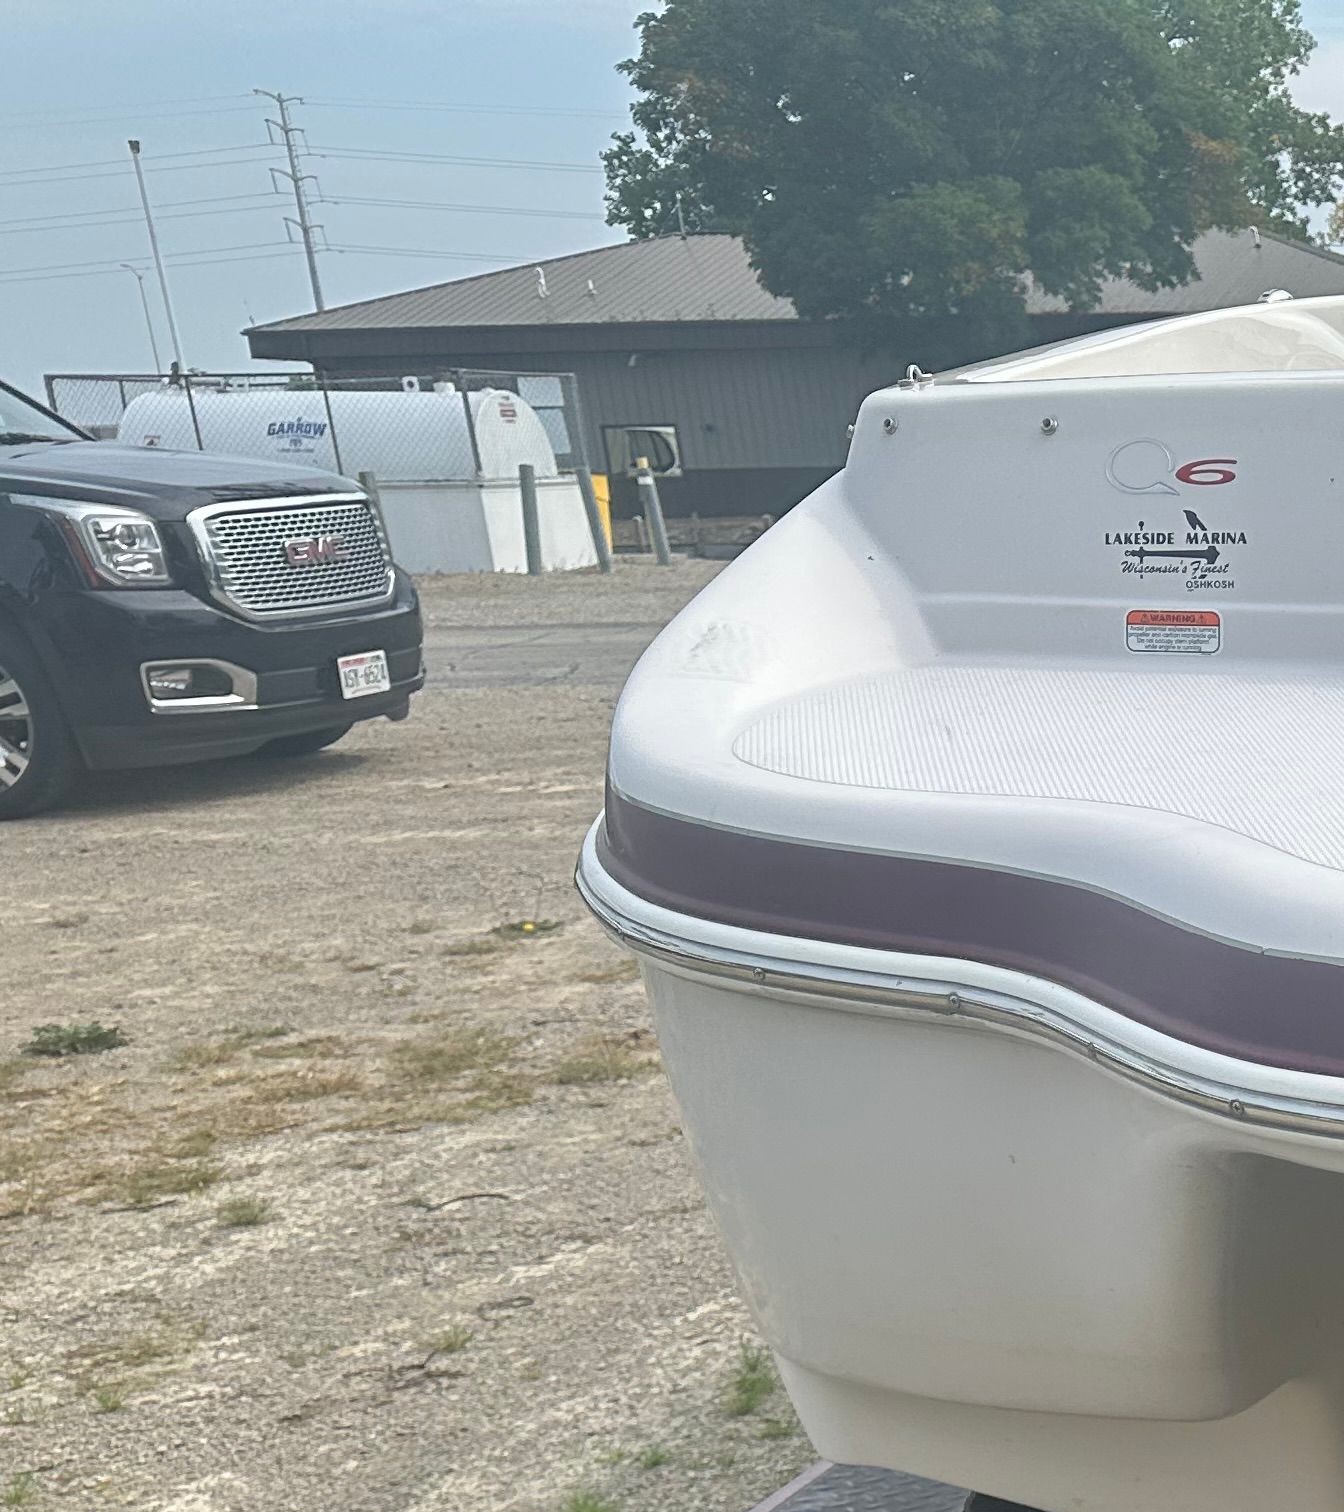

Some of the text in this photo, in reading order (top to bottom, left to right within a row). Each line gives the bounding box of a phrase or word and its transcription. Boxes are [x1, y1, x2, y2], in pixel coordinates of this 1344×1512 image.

[266, 422, 327, 437] GARROW
[1104, 532, 1248, 545] LAKESIDE MARINA
[285, 534, 350, 567] GMC
[1120, 560, 1230, 576] Wisconsin's Finest
[1185, 580, 1235, 589] OSHKOSH
[1150, 614, 1196, 623] WARNING
